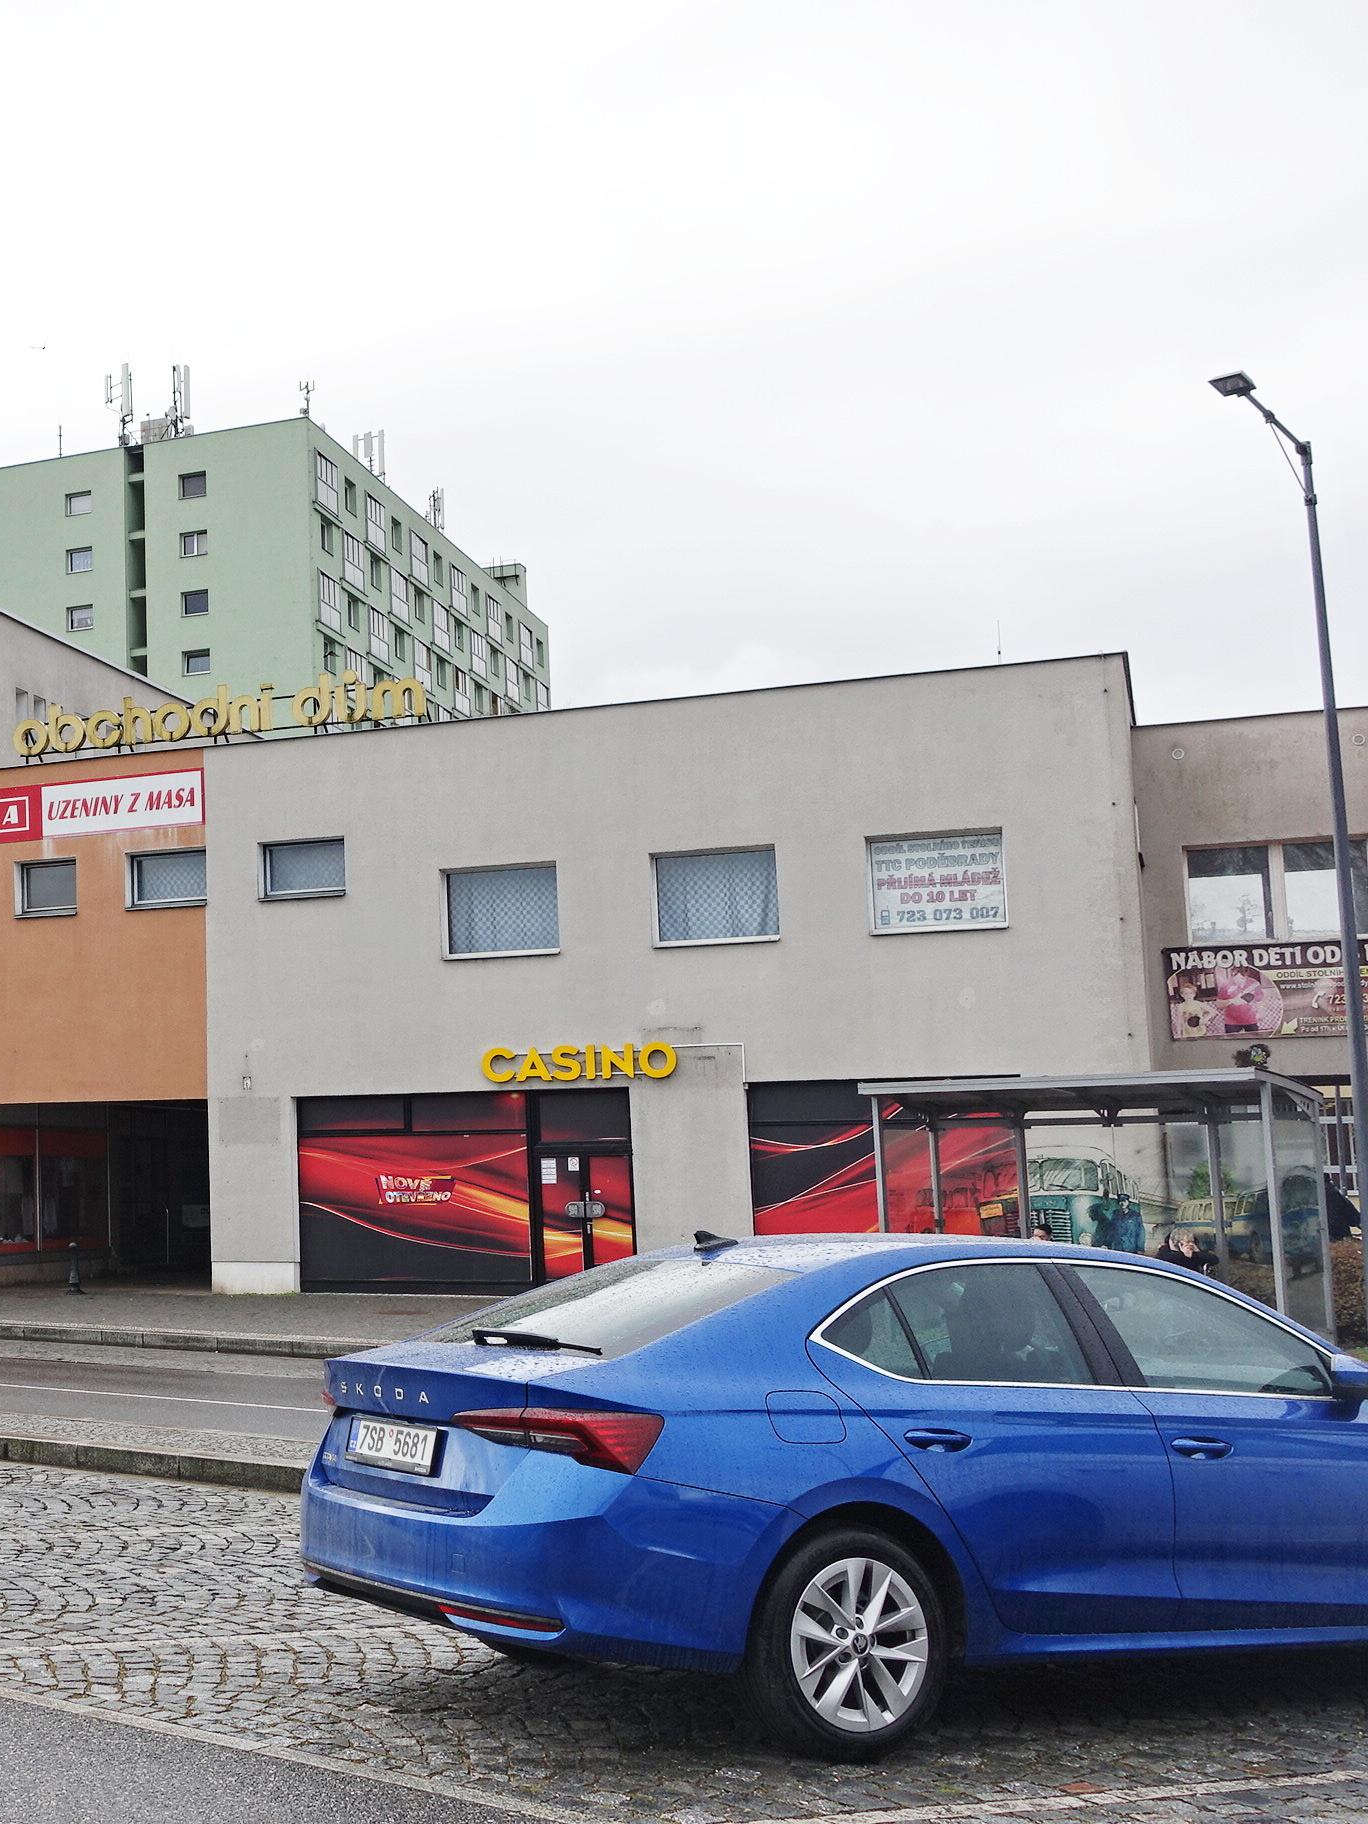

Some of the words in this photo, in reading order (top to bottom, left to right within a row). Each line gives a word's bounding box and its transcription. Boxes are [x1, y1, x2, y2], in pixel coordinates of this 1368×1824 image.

[48, 794, 125, 821] UZENINY
[127, 792, 141, 813] Z
[145, 787, 195, 811] MASA
[875, 859, 902, 872] TTC
[905, 852, 999, 870] PODĚBRADY
[939, 867, 1000, 887] MLÁDEŽ
[900, 892, 923, 904] DO
[926, 891, 945, 903] 10
[949, 889, 977, 902] LET
[896, 910, 927, 922] 723
[933, 908, 963, 921] 073
[969, 906, 1000, 919] 007
[1306, 945, 1341, 964] OD
[1306, 969, 1344, 978] STOLNÍH
[481, 1042, 677, 1084] CASINO
[359, 1425, 386, 1453] 7SB
[393, 1430, 428, 1461] 5681
